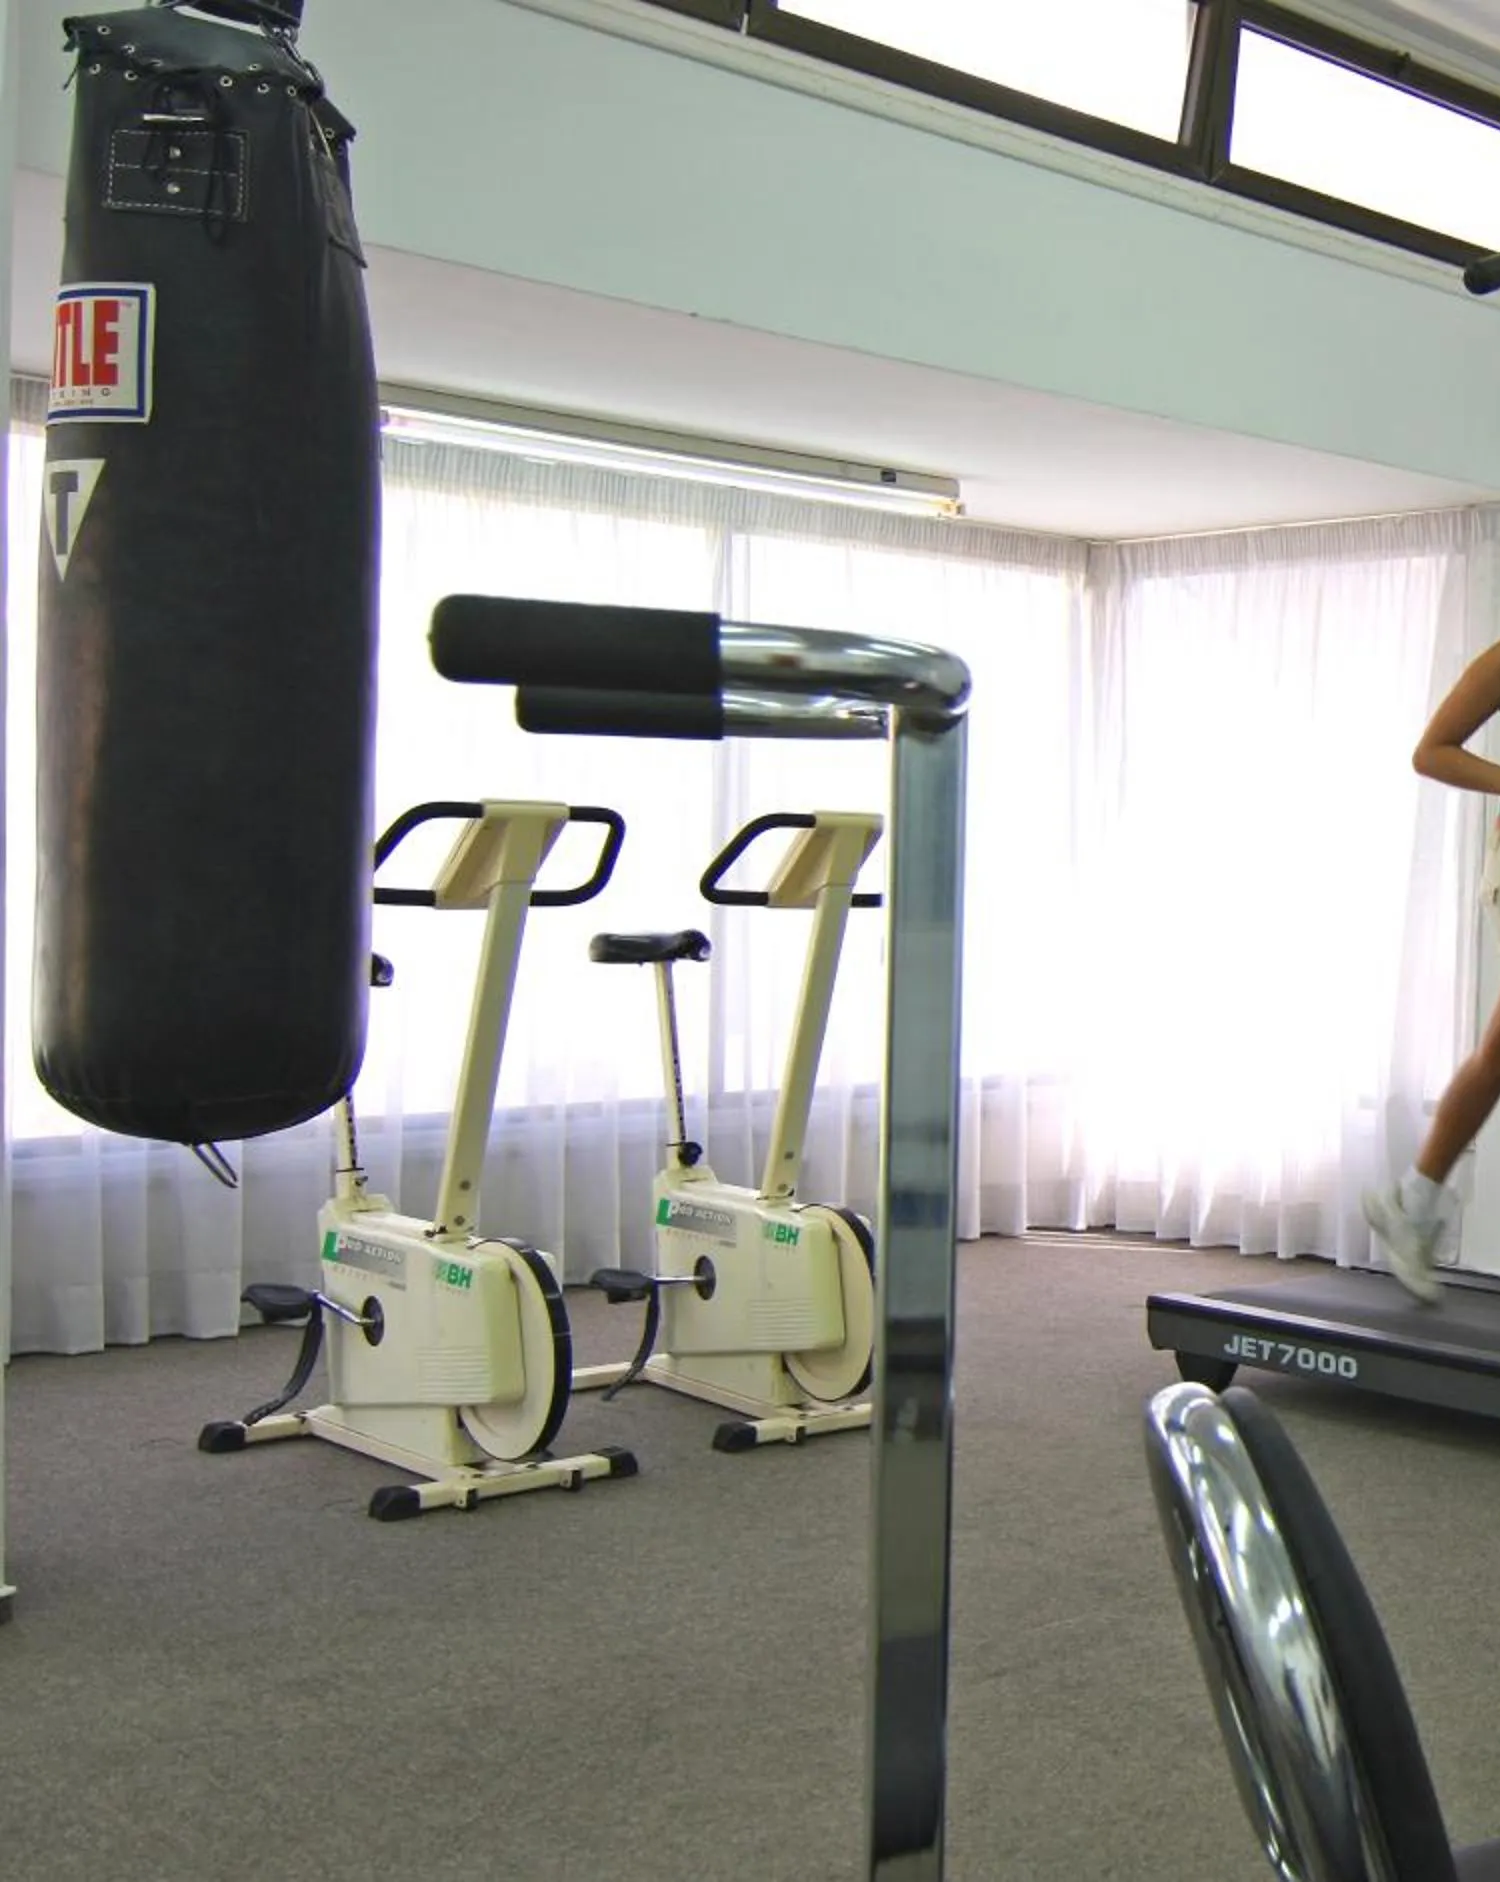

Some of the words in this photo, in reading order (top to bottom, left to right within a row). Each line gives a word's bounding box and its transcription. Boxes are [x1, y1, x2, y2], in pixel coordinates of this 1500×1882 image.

[50, 471, 78, 555] T
[775, 1223, 800, 1246] BH
[447, 1263, 473, 1289] BH
